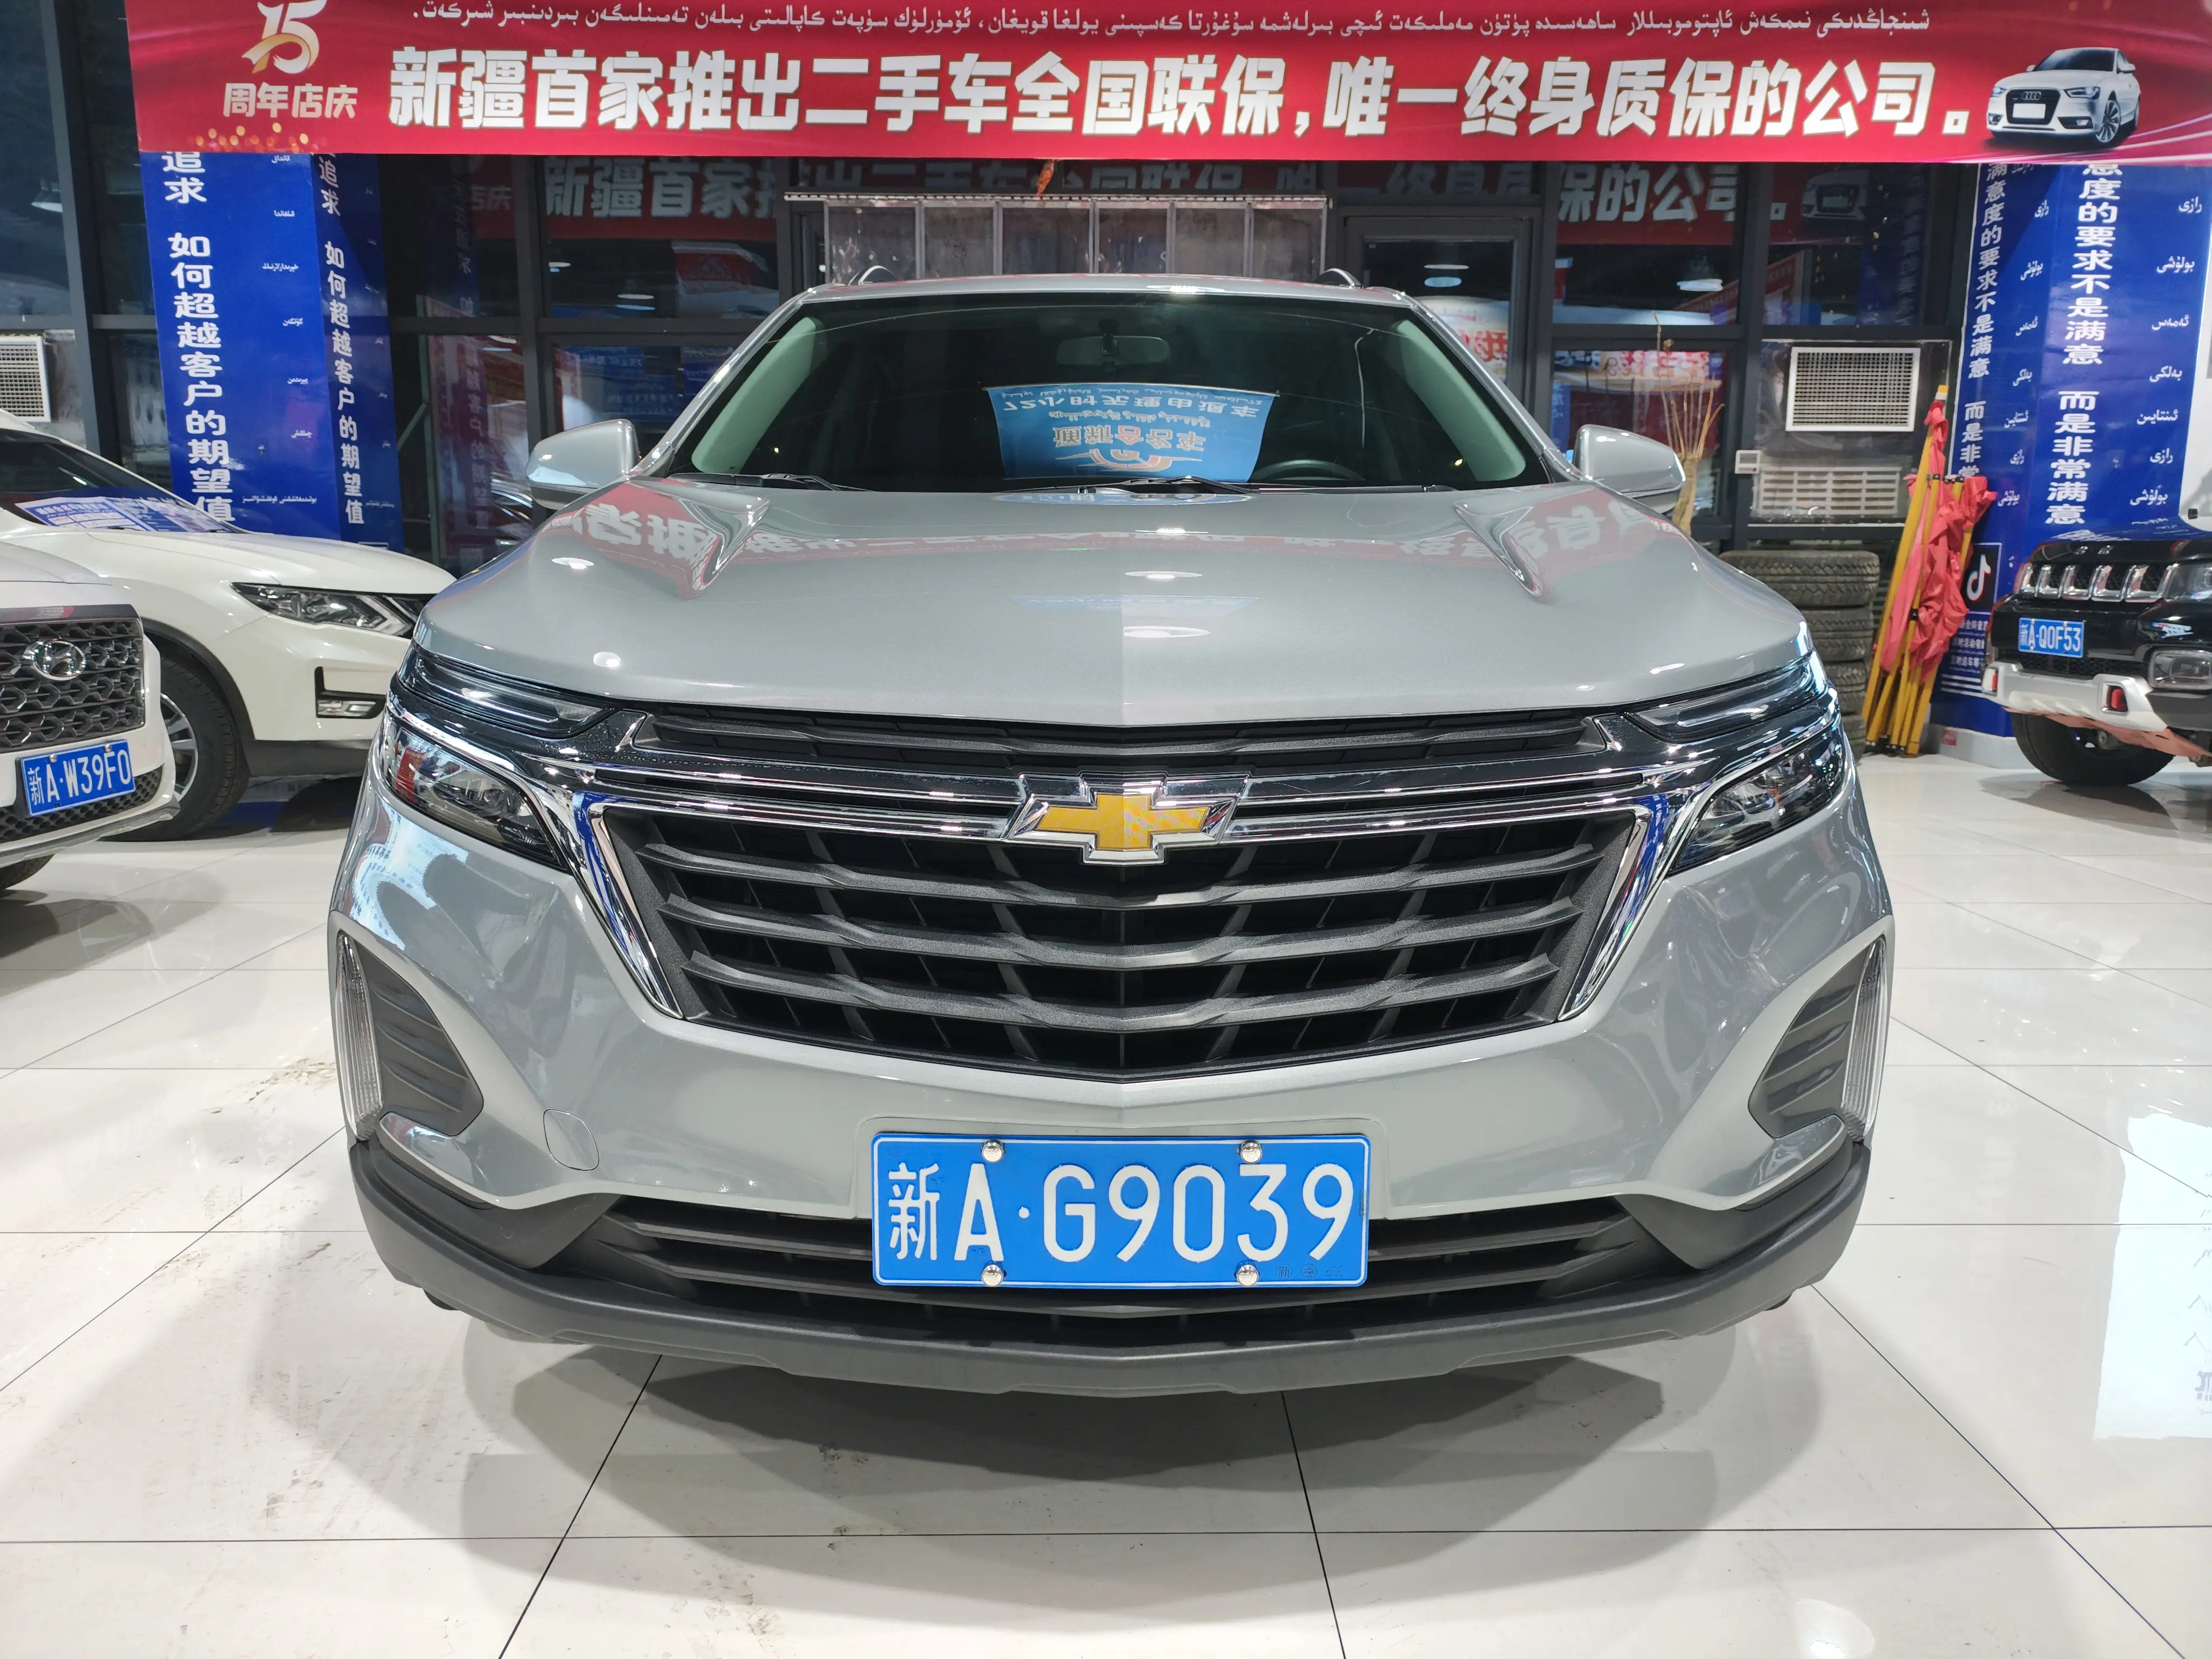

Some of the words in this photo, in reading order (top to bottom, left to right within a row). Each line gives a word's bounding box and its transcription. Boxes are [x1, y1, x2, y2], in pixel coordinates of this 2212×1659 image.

[222, 82, 359, 119] 周年店庆
[241, 0, 327, 74] 15
[161, 152, 207, 204] 追求
[1968, 163, 2007, 380] 满意度的要求不是满意
[168, 232, 236, 522] 如何超越客户的期望值
[324, 241, 365, 525] 如何超越客户的期望值
[2045, 390, 2100, 524] 而是非常满意
